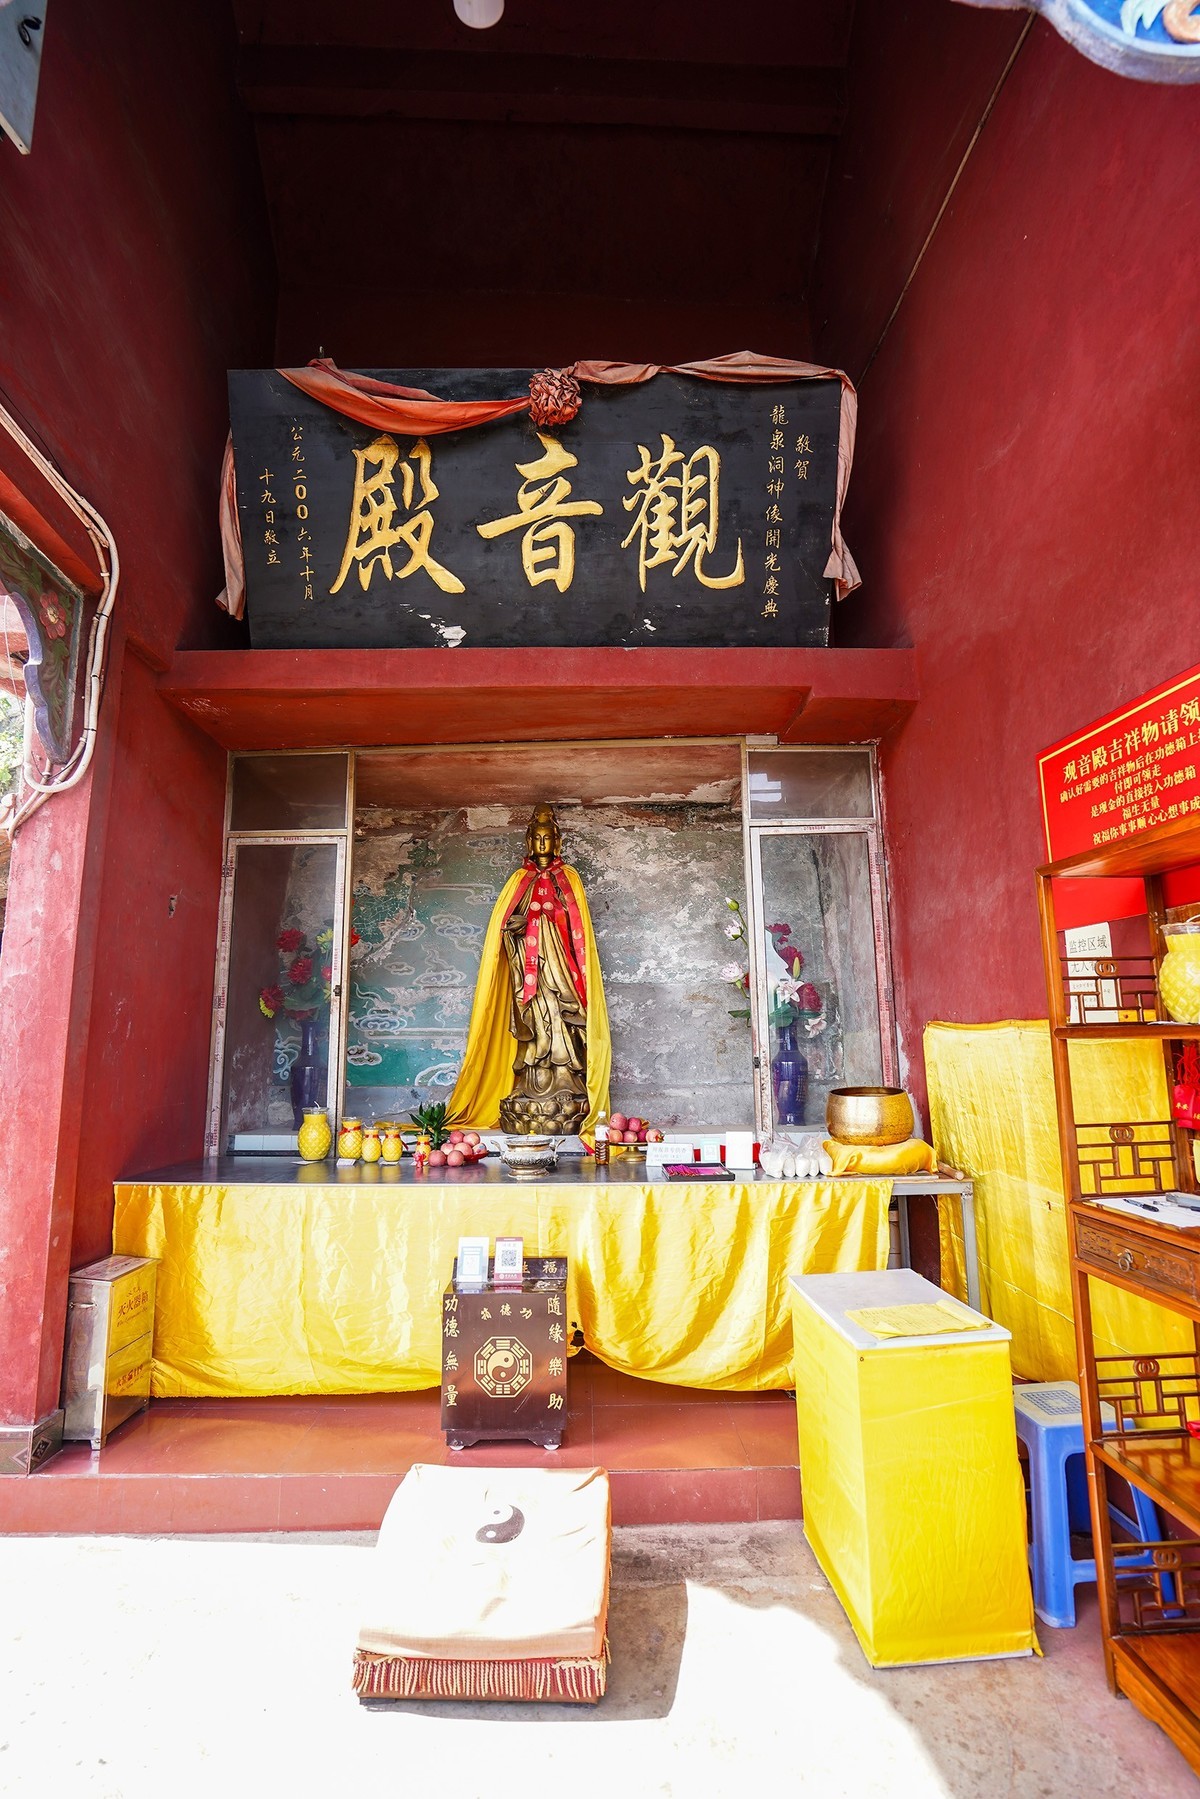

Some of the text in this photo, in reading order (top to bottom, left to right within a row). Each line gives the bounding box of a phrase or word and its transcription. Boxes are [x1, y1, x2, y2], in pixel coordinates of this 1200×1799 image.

[793, 434, 814, 480] 敬賀
[258, 468, 281, 565] 十九日敬立
[328, 432, 746, 595] 觀音殿
[1060, 729, 1200, 803] 确认好需要的吉祥物后在功德箱上
[1063, 696, 1200, 784] 观音殿吉祥物请领
[1090, 765, 1197, 818] 是现金的直接投入功德箱
[1122, 795, 1160, 821] 福生无量
[443, 1295, 460, 1408] 功德無量
[547, 1294, 565, 1411] 隨緣樂助
